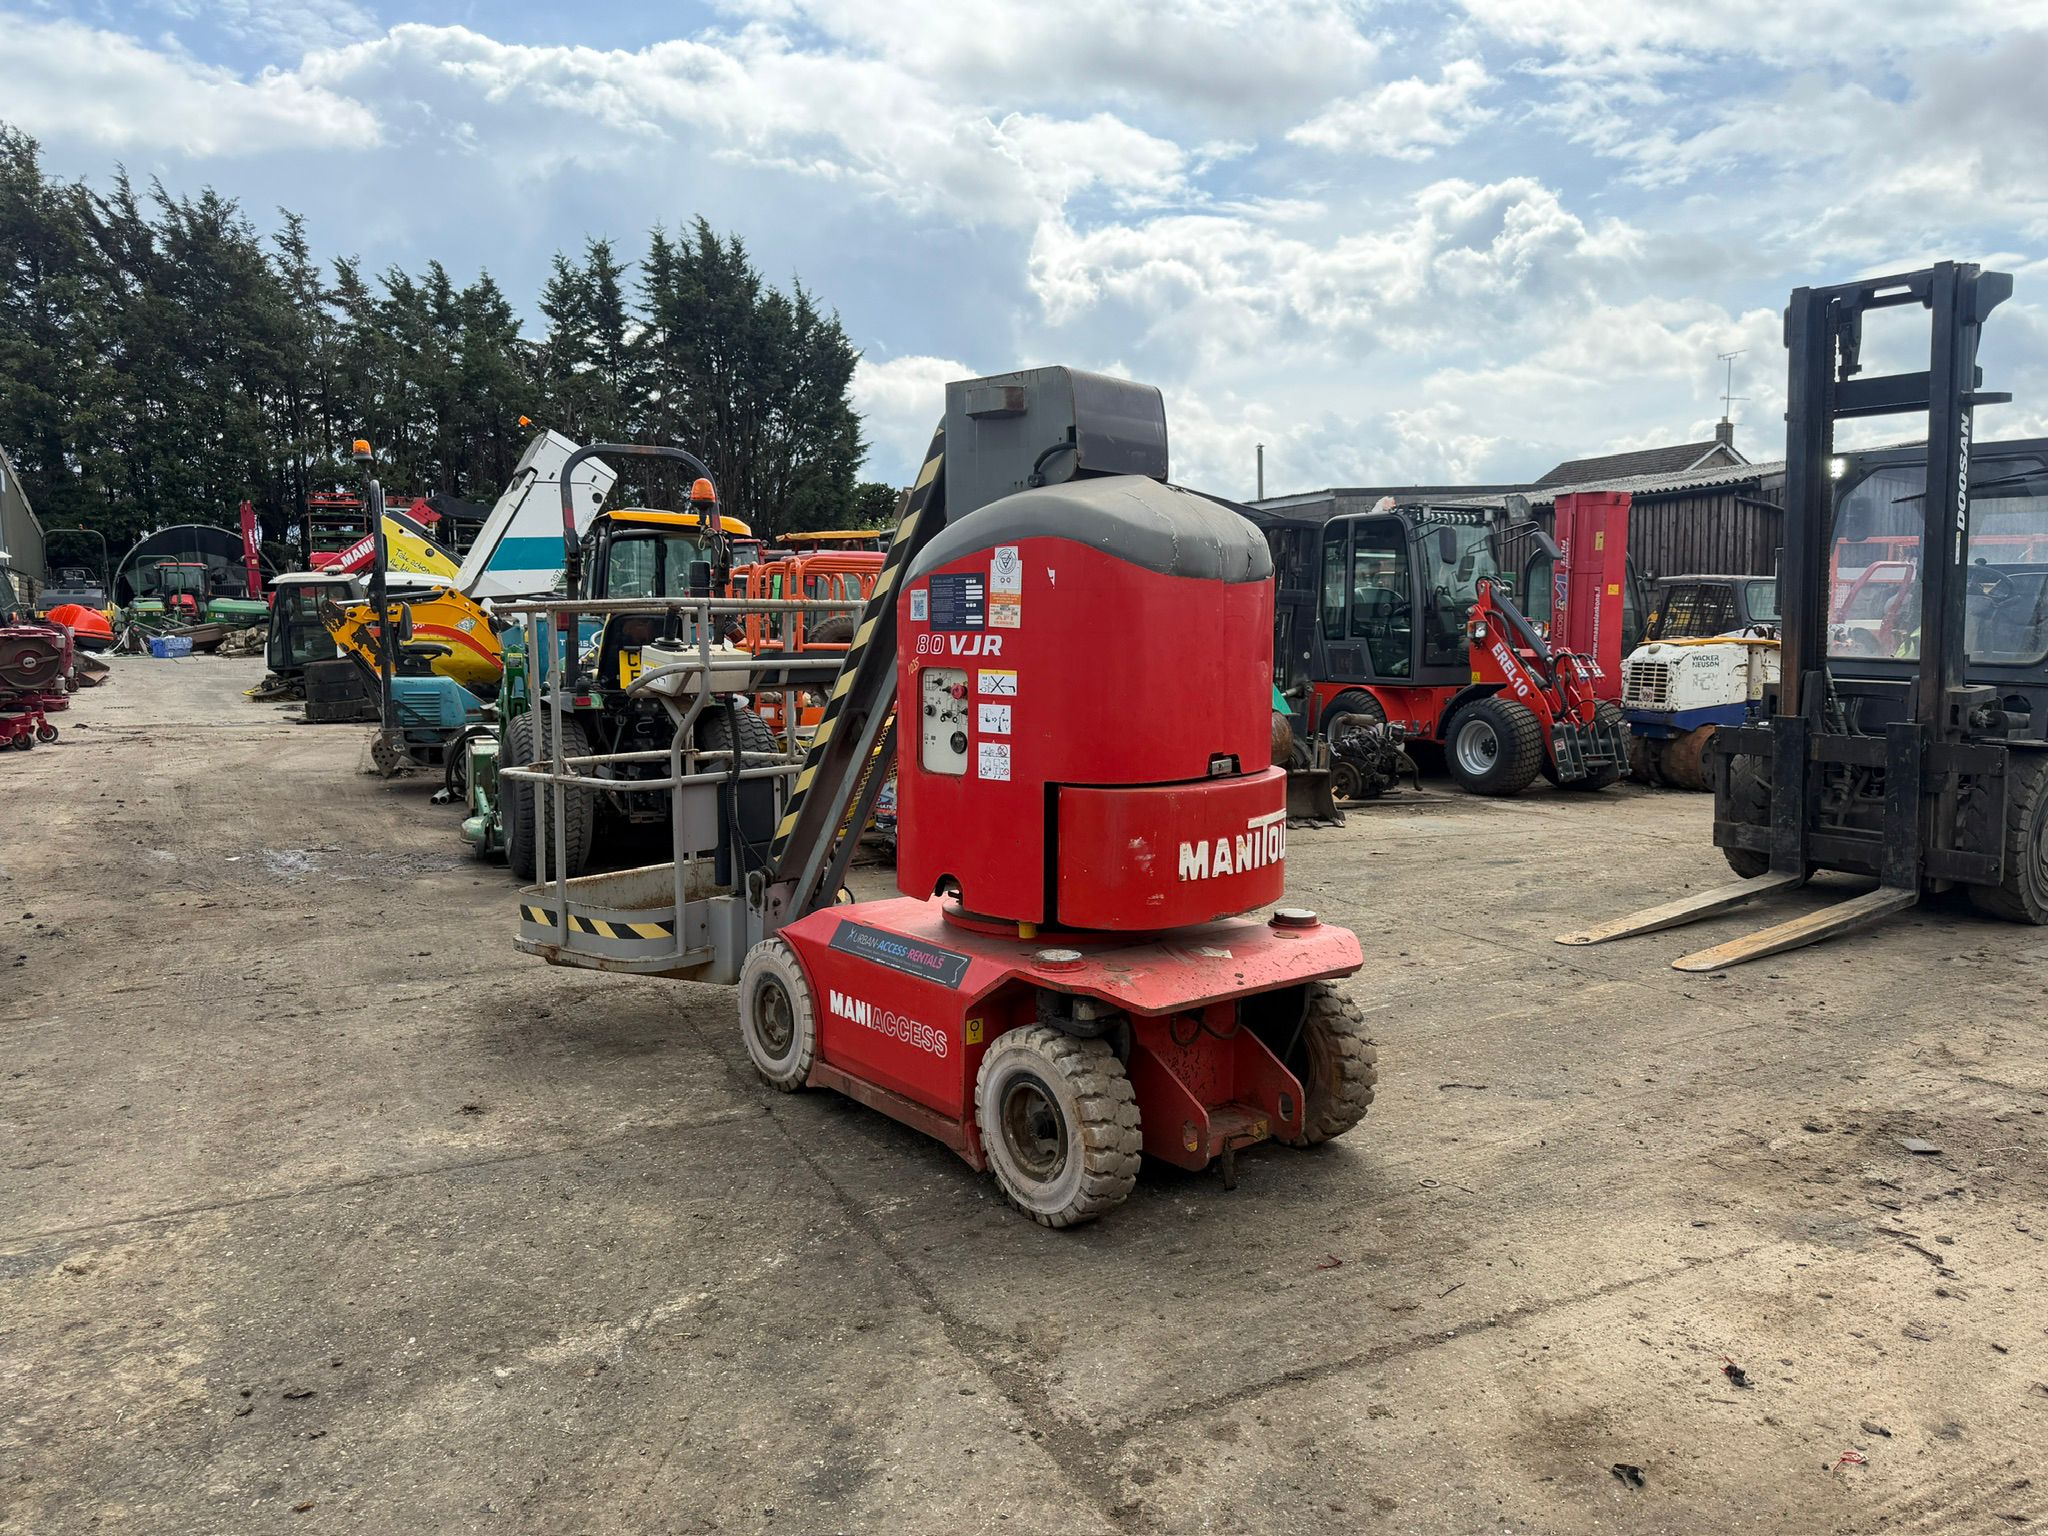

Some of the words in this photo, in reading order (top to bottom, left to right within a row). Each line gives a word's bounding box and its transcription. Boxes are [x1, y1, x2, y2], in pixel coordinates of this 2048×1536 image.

[1957, 413, 1970, 531] DOOSAN
[916, 634, 945, 655] 80
[949, 634, 1003, 656] VJR
[1178, 808, 1287, 881] MANITOU
